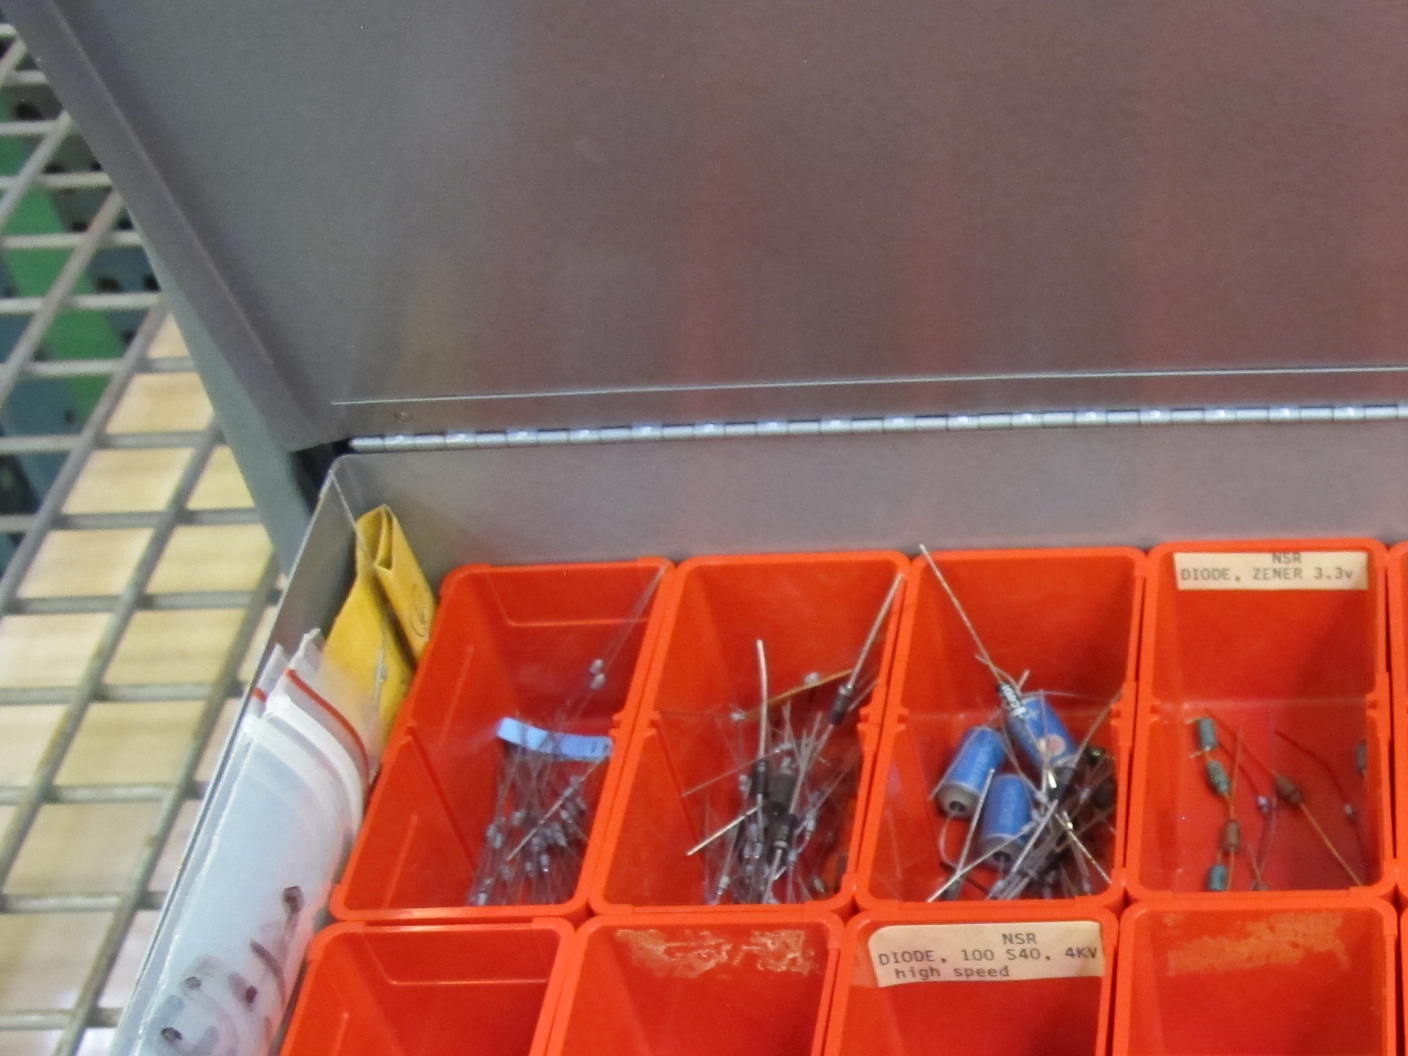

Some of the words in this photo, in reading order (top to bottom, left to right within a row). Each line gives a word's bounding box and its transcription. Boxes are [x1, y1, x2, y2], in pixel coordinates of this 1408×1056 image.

[1271, 551, 1303, 565] NSR
[1180, 567, 1242, 582] DIODE,
[1252, 567, 1303, 581] ZENER
[1313, 566, 1354, 581] 3.3v
[1002, 932, 1037, 945] NSR
[960, 948, 995, 962] 100
[1065, 947, 1098, 960] 4KV
[894, 966, 941, 981] high
[953, 965, 1010, 979] speed
